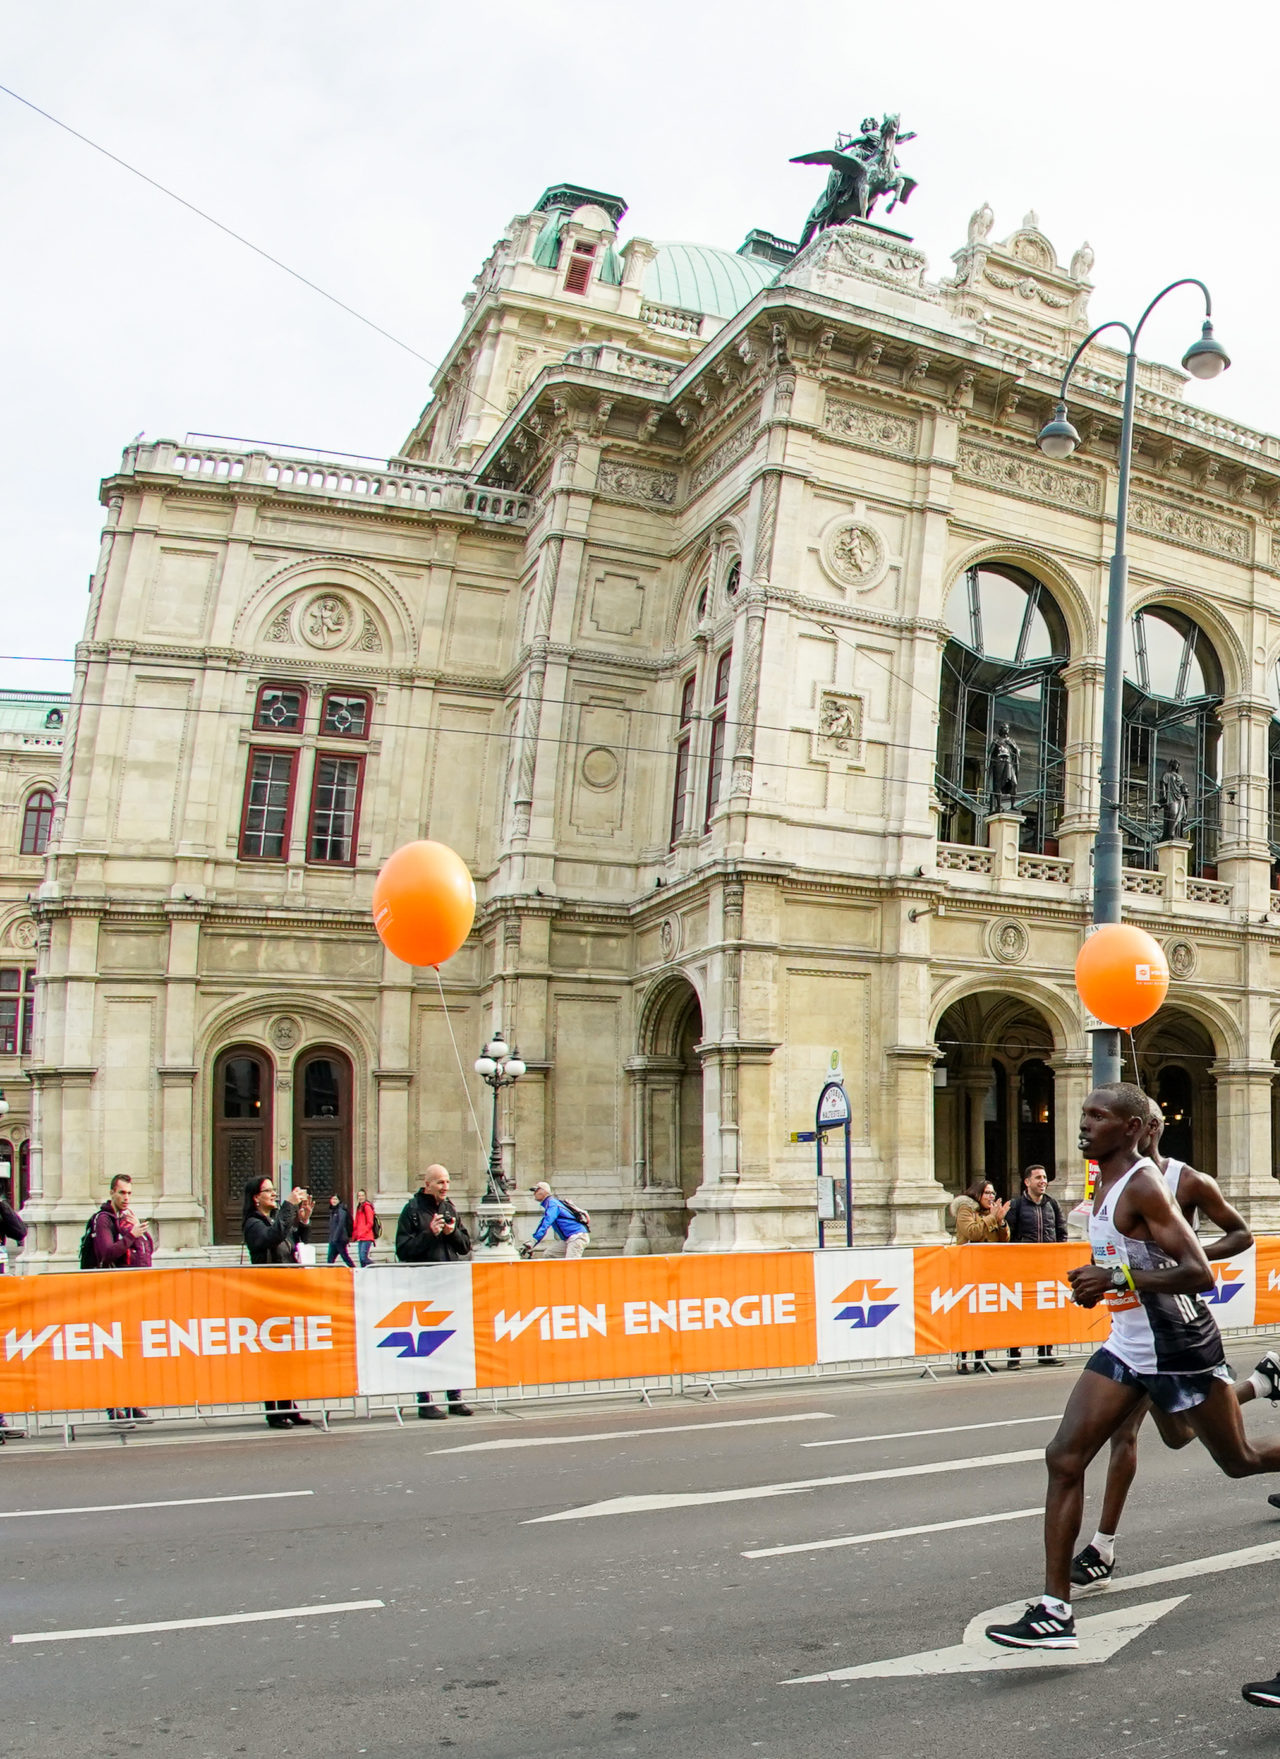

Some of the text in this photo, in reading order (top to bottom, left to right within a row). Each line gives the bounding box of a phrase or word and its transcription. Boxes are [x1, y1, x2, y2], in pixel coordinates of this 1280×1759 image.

[494, 1291, 797, 1342] WIEN ENERGIE
[931, 1281, 1023, 1316] WIEN
[4, 1314, 333, 1362] WIEN ENERGIE
